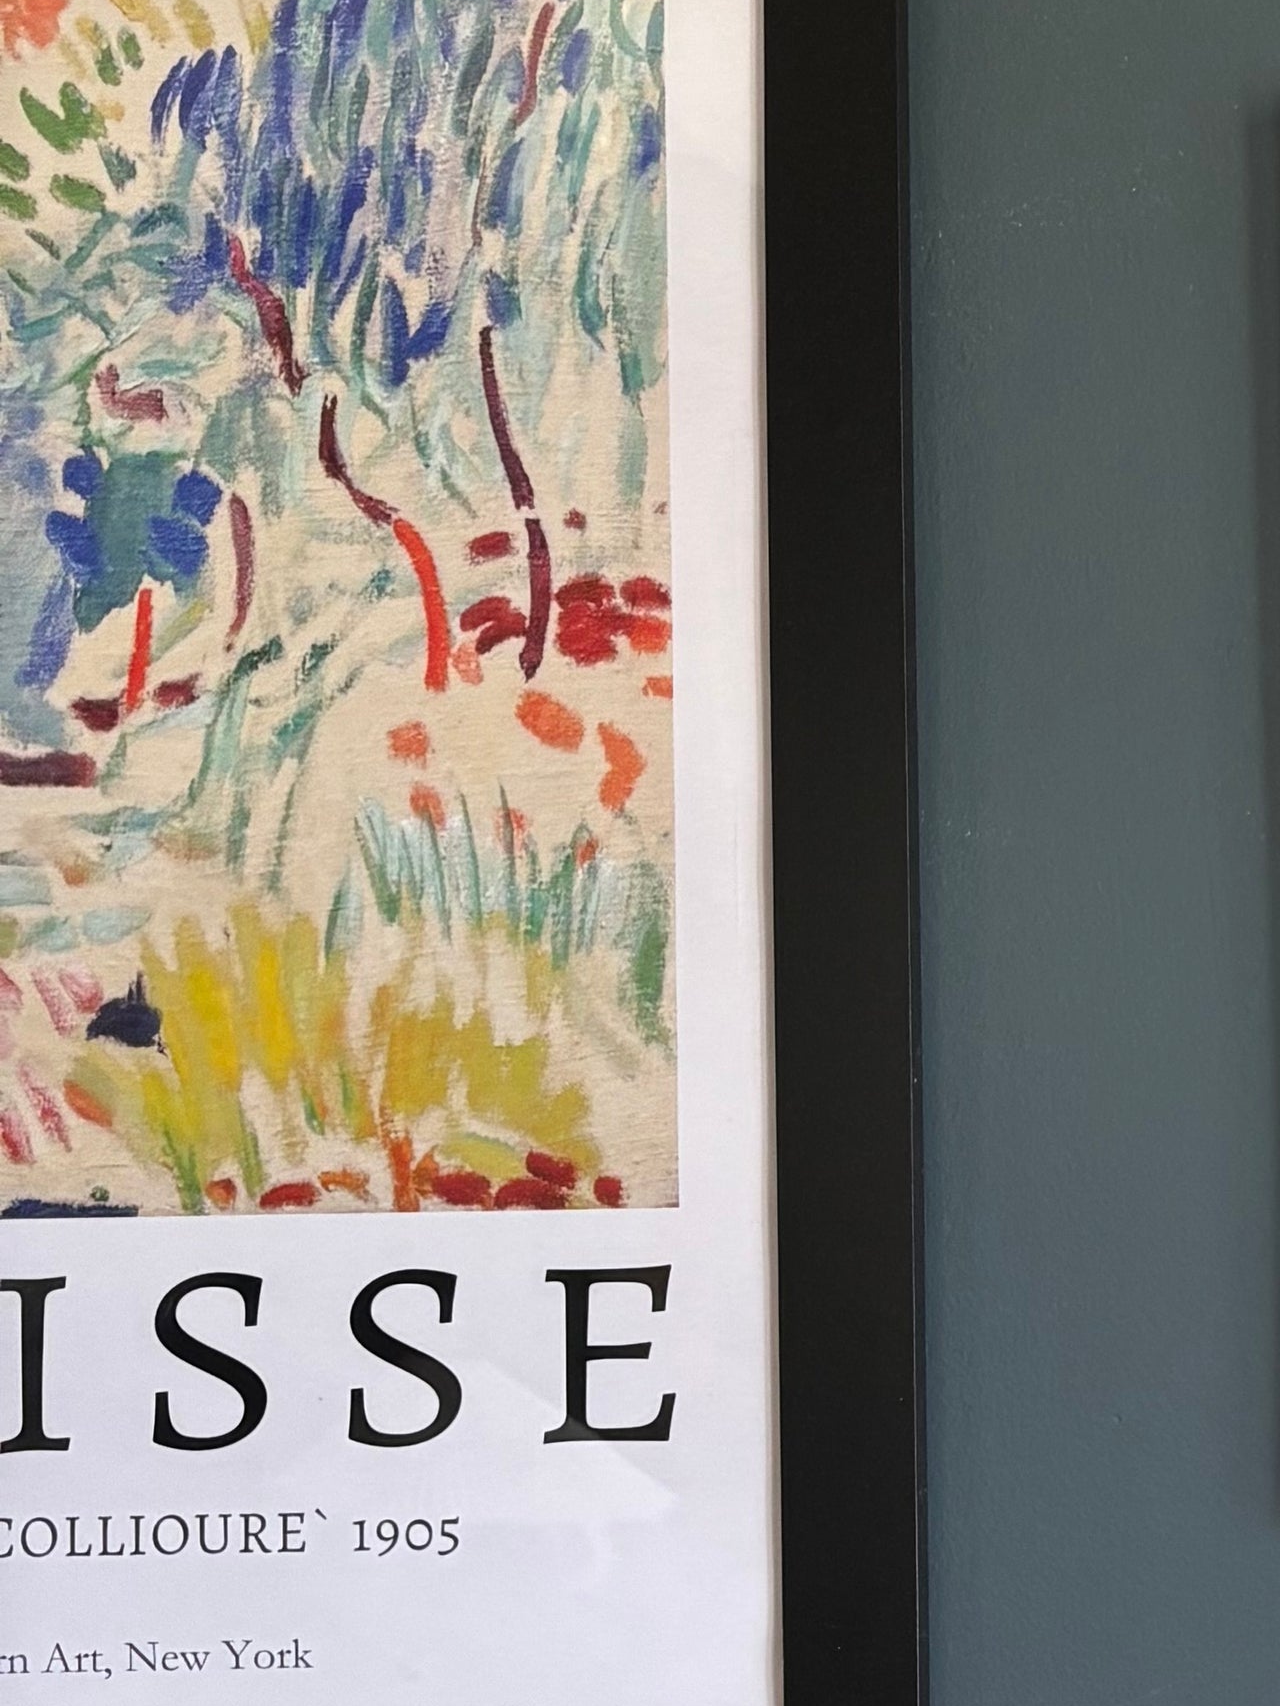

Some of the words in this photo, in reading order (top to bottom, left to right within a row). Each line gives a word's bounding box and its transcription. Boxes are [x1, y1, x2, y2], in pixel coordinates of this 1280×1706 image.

[0, 1263, 677, 1454] ISSE
[352, 1515, 461, 1557] 1905
[42, 1642, 112, 1680] Art,
[124, 1641, 210, 1673] New
[221, 1638, 314, 1671] York
